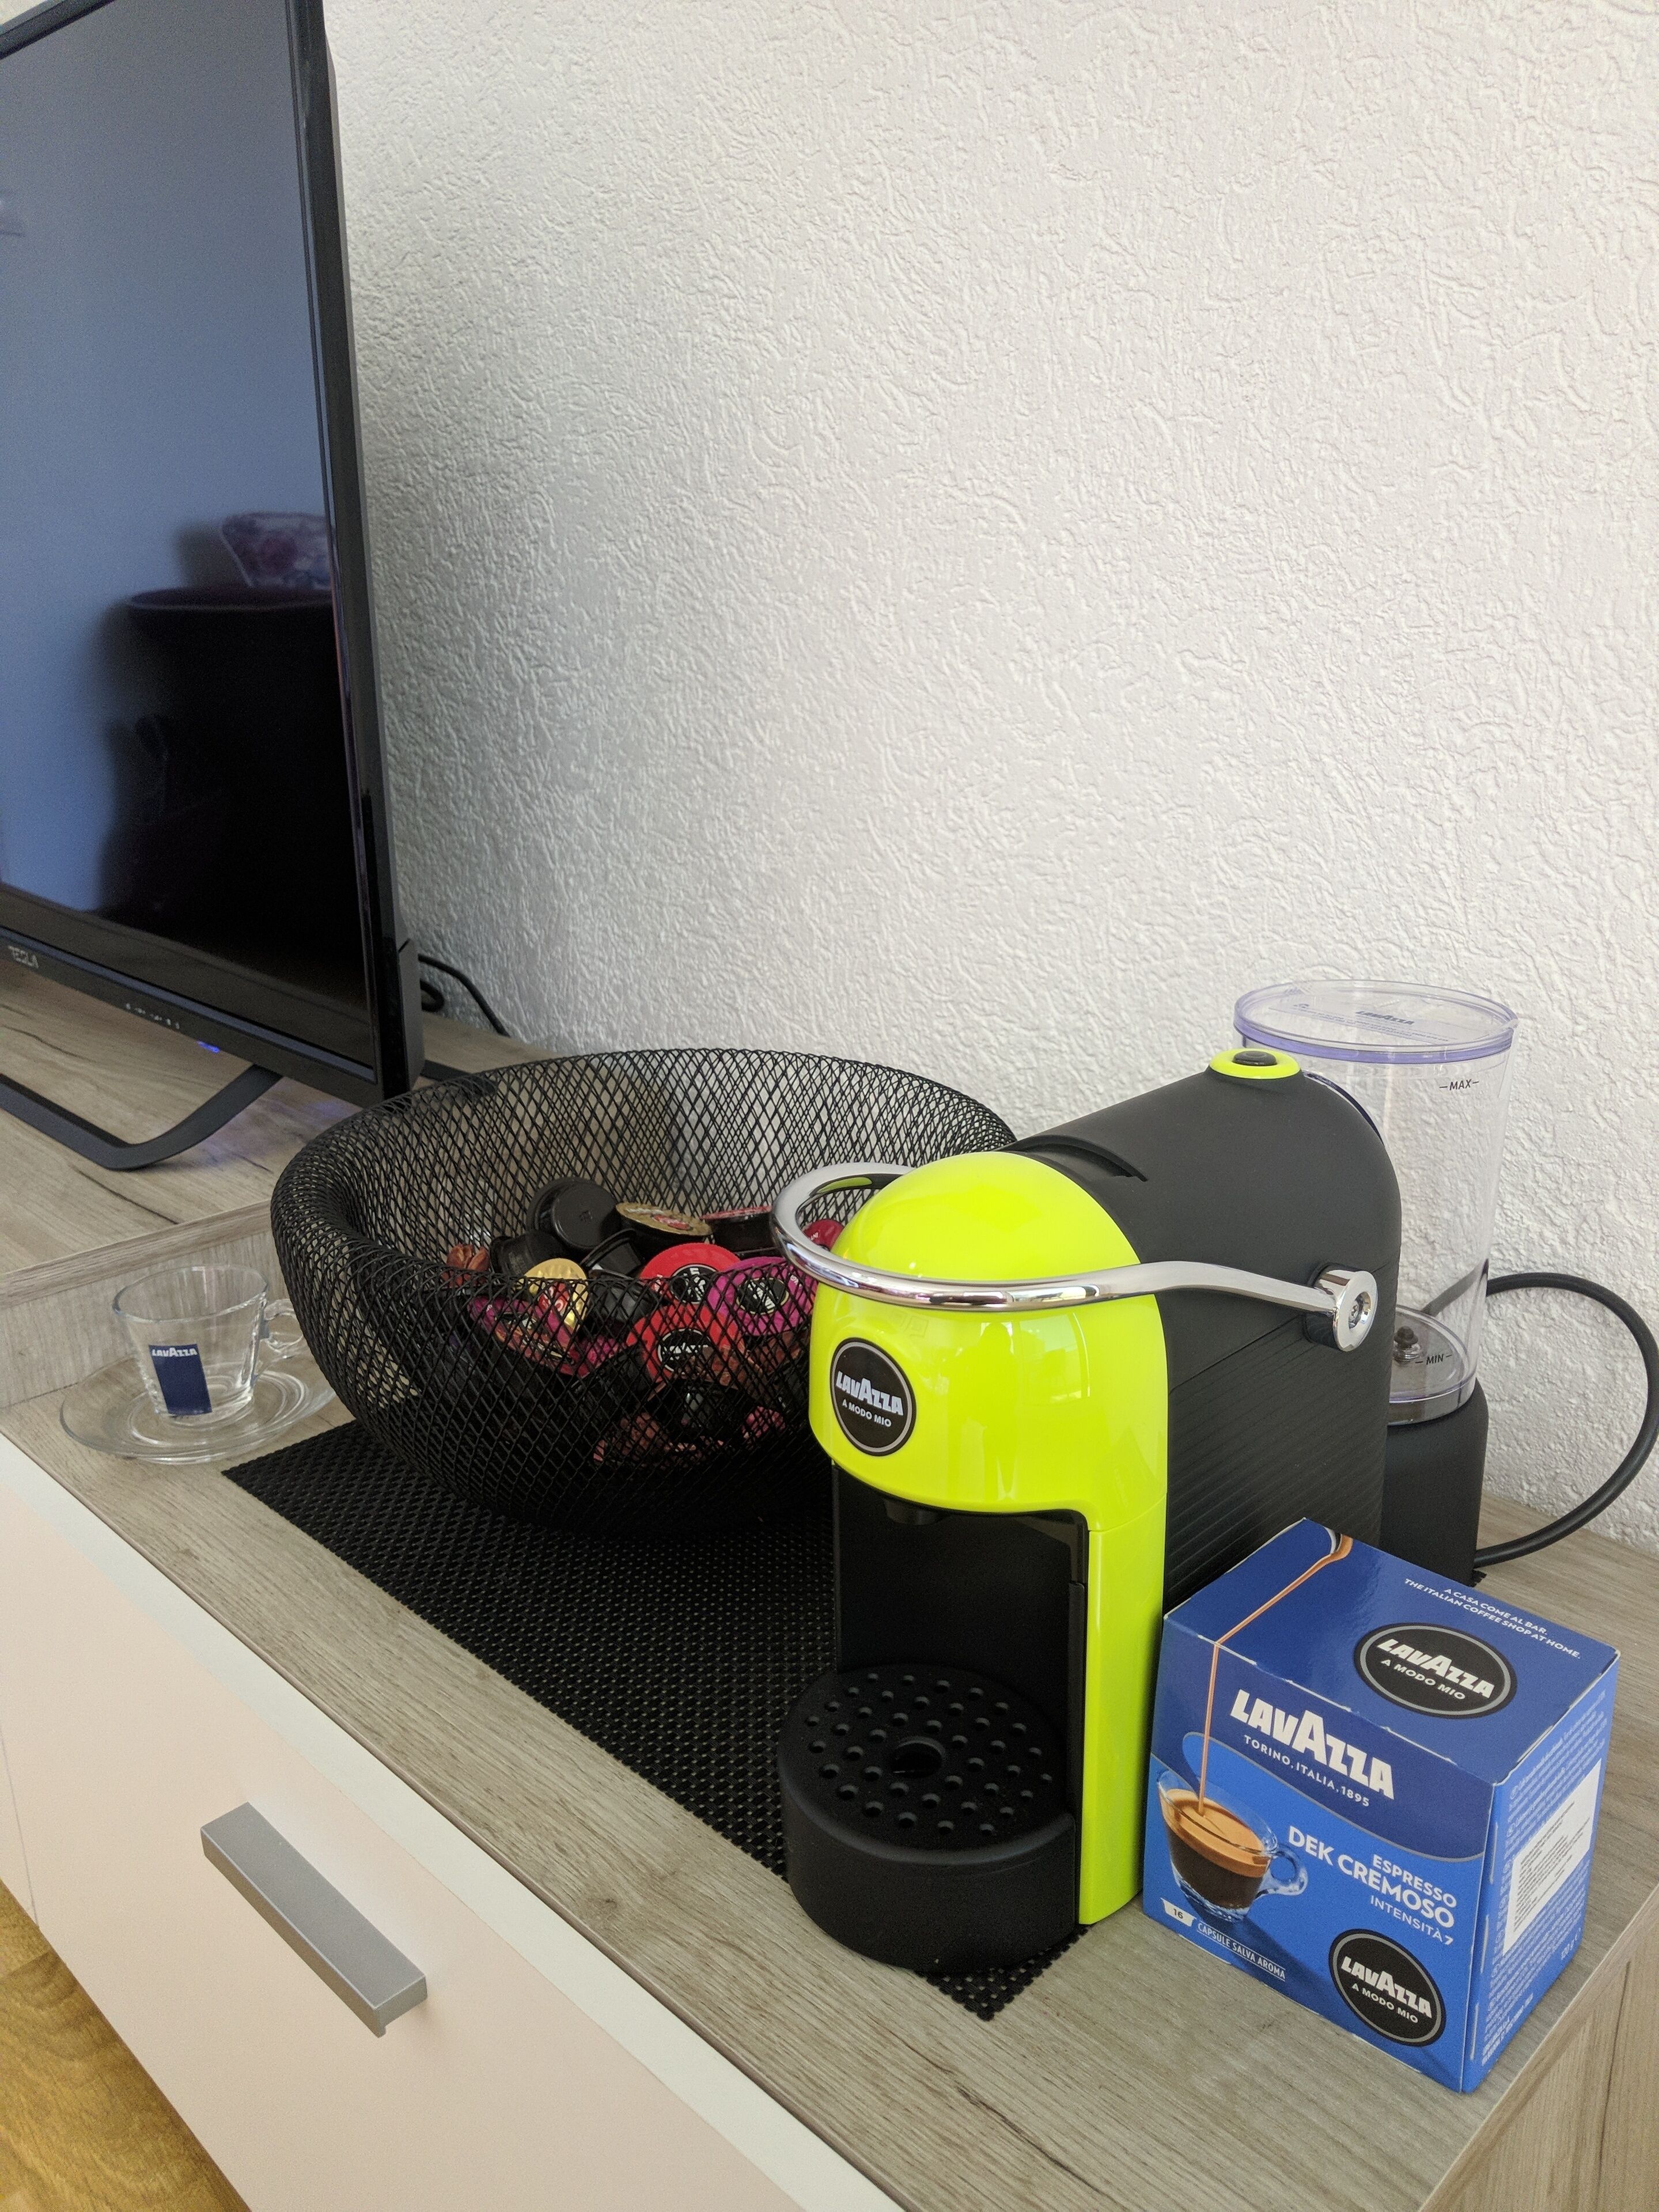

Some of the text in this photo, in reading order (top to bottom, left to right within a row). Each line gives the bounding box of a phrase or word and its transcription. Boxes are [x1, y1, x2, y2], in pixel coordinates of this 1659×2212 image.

[1449, 1079, 1472, 1090] MAX
[151, 1347, 198, 1357] LAVAZZA
[1426, 1354, 1444, 1365] MIN
[836, 1371, 904, 1416] LAVAZZA
[842, 1399, 892, 1427] A MODO MIO
[1404, 1578, 1581, 1659] THE ITALIAN COFFEE SHOP AT HOME.
[1453, 1591, 1479, 1605] CASA
[1480, 1602, 1512, 1618] COME
[1510, 1616, 1524, 1627] AL
[1525, 1620, 1547, 1635] BAR.
[1377, 1639, 1495, 1698] LAVAZZA
[1393, 1664, 1436, 1685] MODO
[1438, 1684, 1465, 1699] MIO
[1230, 1689, 1394, 1800] LAVAZZA
[1244, 1734, 1294, 1769] TORINO,
[1341, 1786, 1369, 1807] 1895
[1289, 1825, 1334, 1866] DEK
[1337, 1854, 1455, 1928] CREMOSO
[1373, 1854, 1457, 1908] ESPRESSO
[1173, 1908, 1184, 1919] 16
[1370, 1895, 1454, 1945] INTENSITÀ 7
[1198, 1922, 1286, 1979] CAPSULE SALVA AROMA
[1341, 1956, 1432, 2018] LAVAZZA
[1351, 1983, 1418, 2024] A MODO MIO
